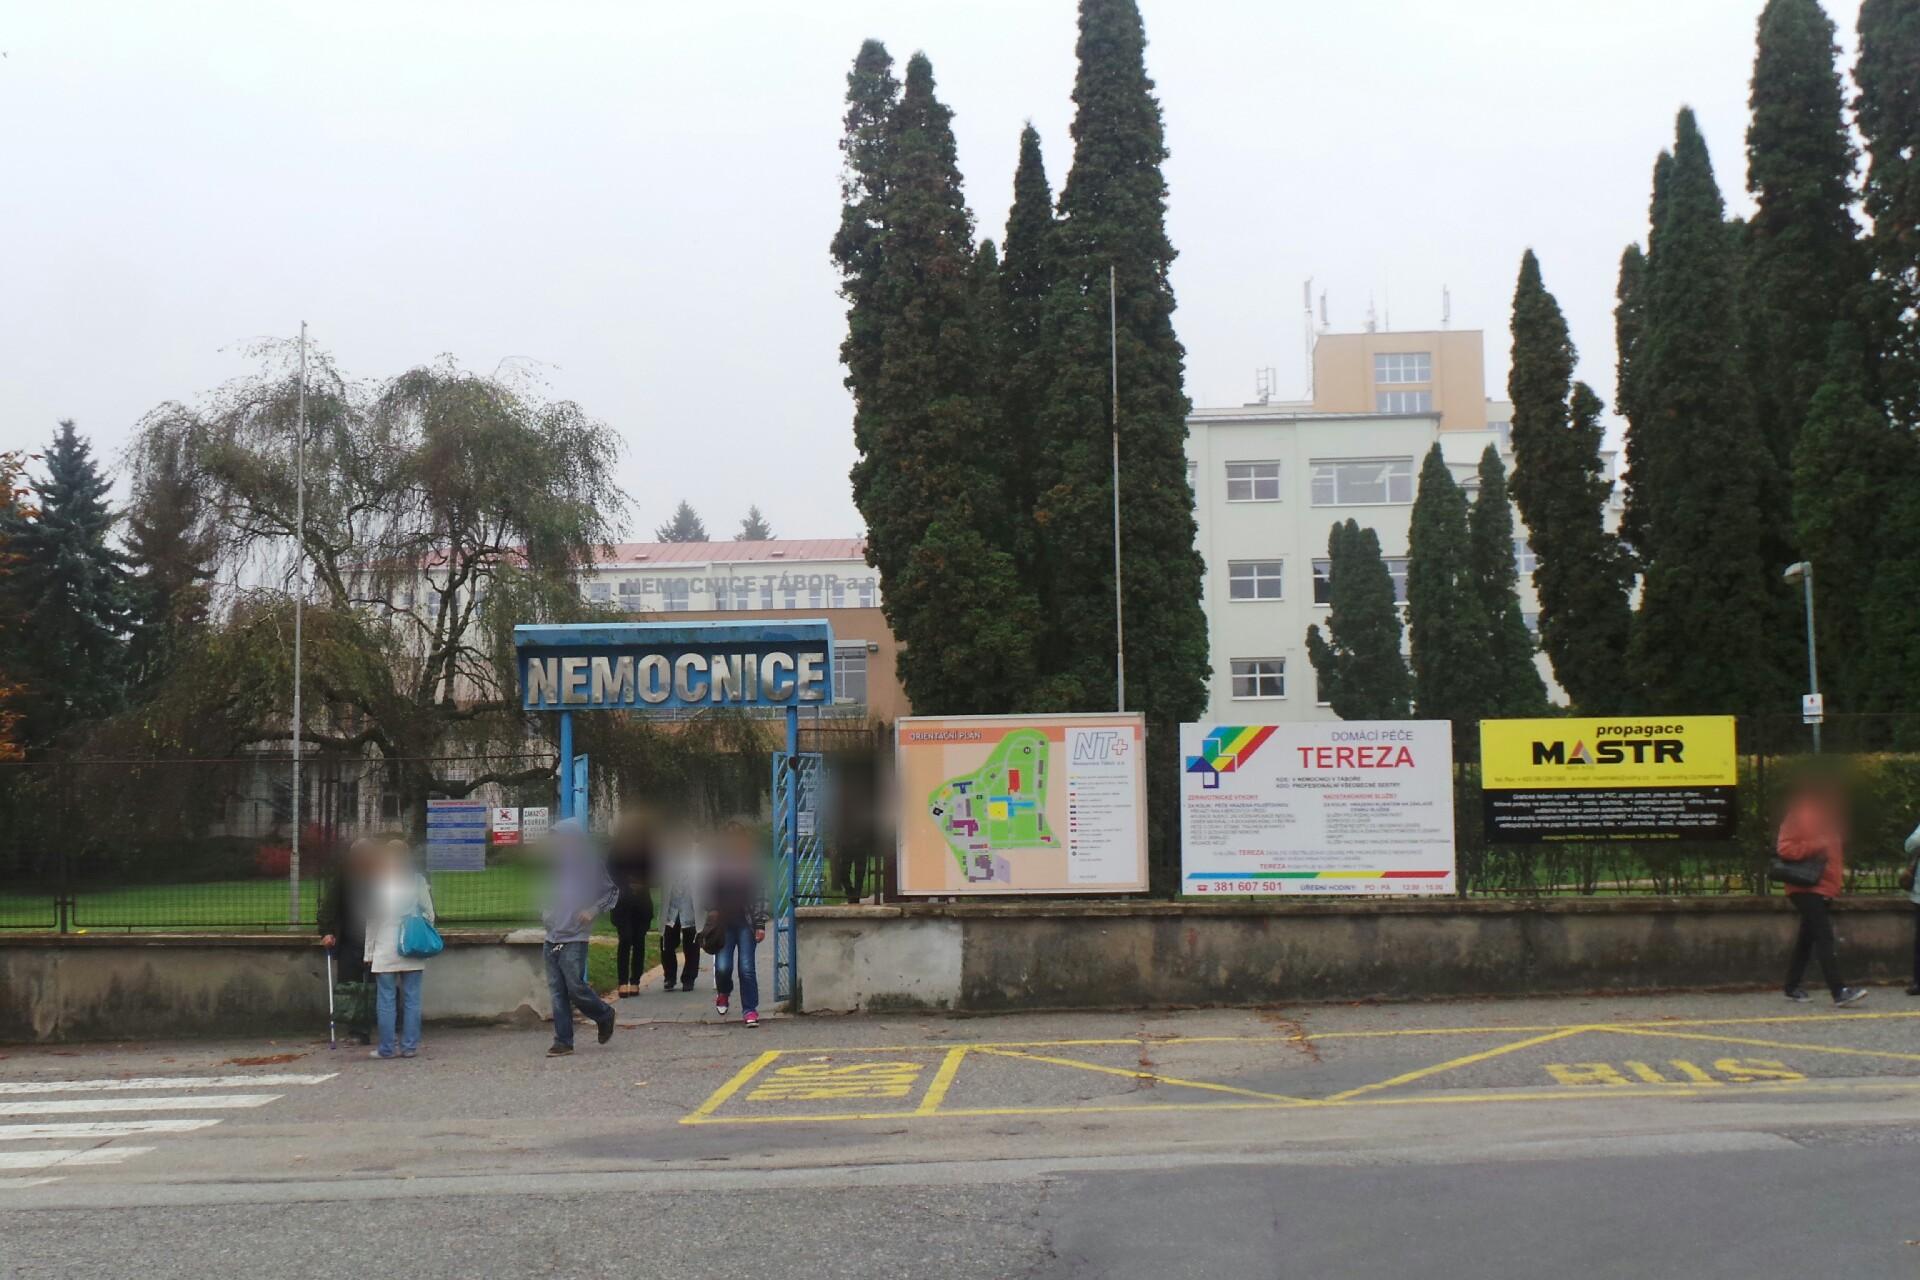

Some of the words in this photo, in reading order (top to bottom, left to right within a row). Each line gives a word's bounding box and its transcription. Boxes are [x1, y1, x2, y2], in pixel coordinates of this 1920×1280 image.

[626, 575, 756, 595] NEMOCNICE
[763, 571, 838, 592] TÁBOR
[528, 652, 825, 704] NEMOCNICE
[1331, 729, 1379, 741] DOMÁCÍ
[1382, 729, 1414, 741] PÉČE
[1596, 724, 1684, 738] propagace
[1297, 746, 1415, 768] TEREZA
[1532, 739, 1684, 765] MASTR
[1214, 882, 1234, 892] 381
[1238, 882, 1258, 892] 607
[1262, 882, 1282, 892] 501
[1542, 1057, 1809, 1087] BUS
